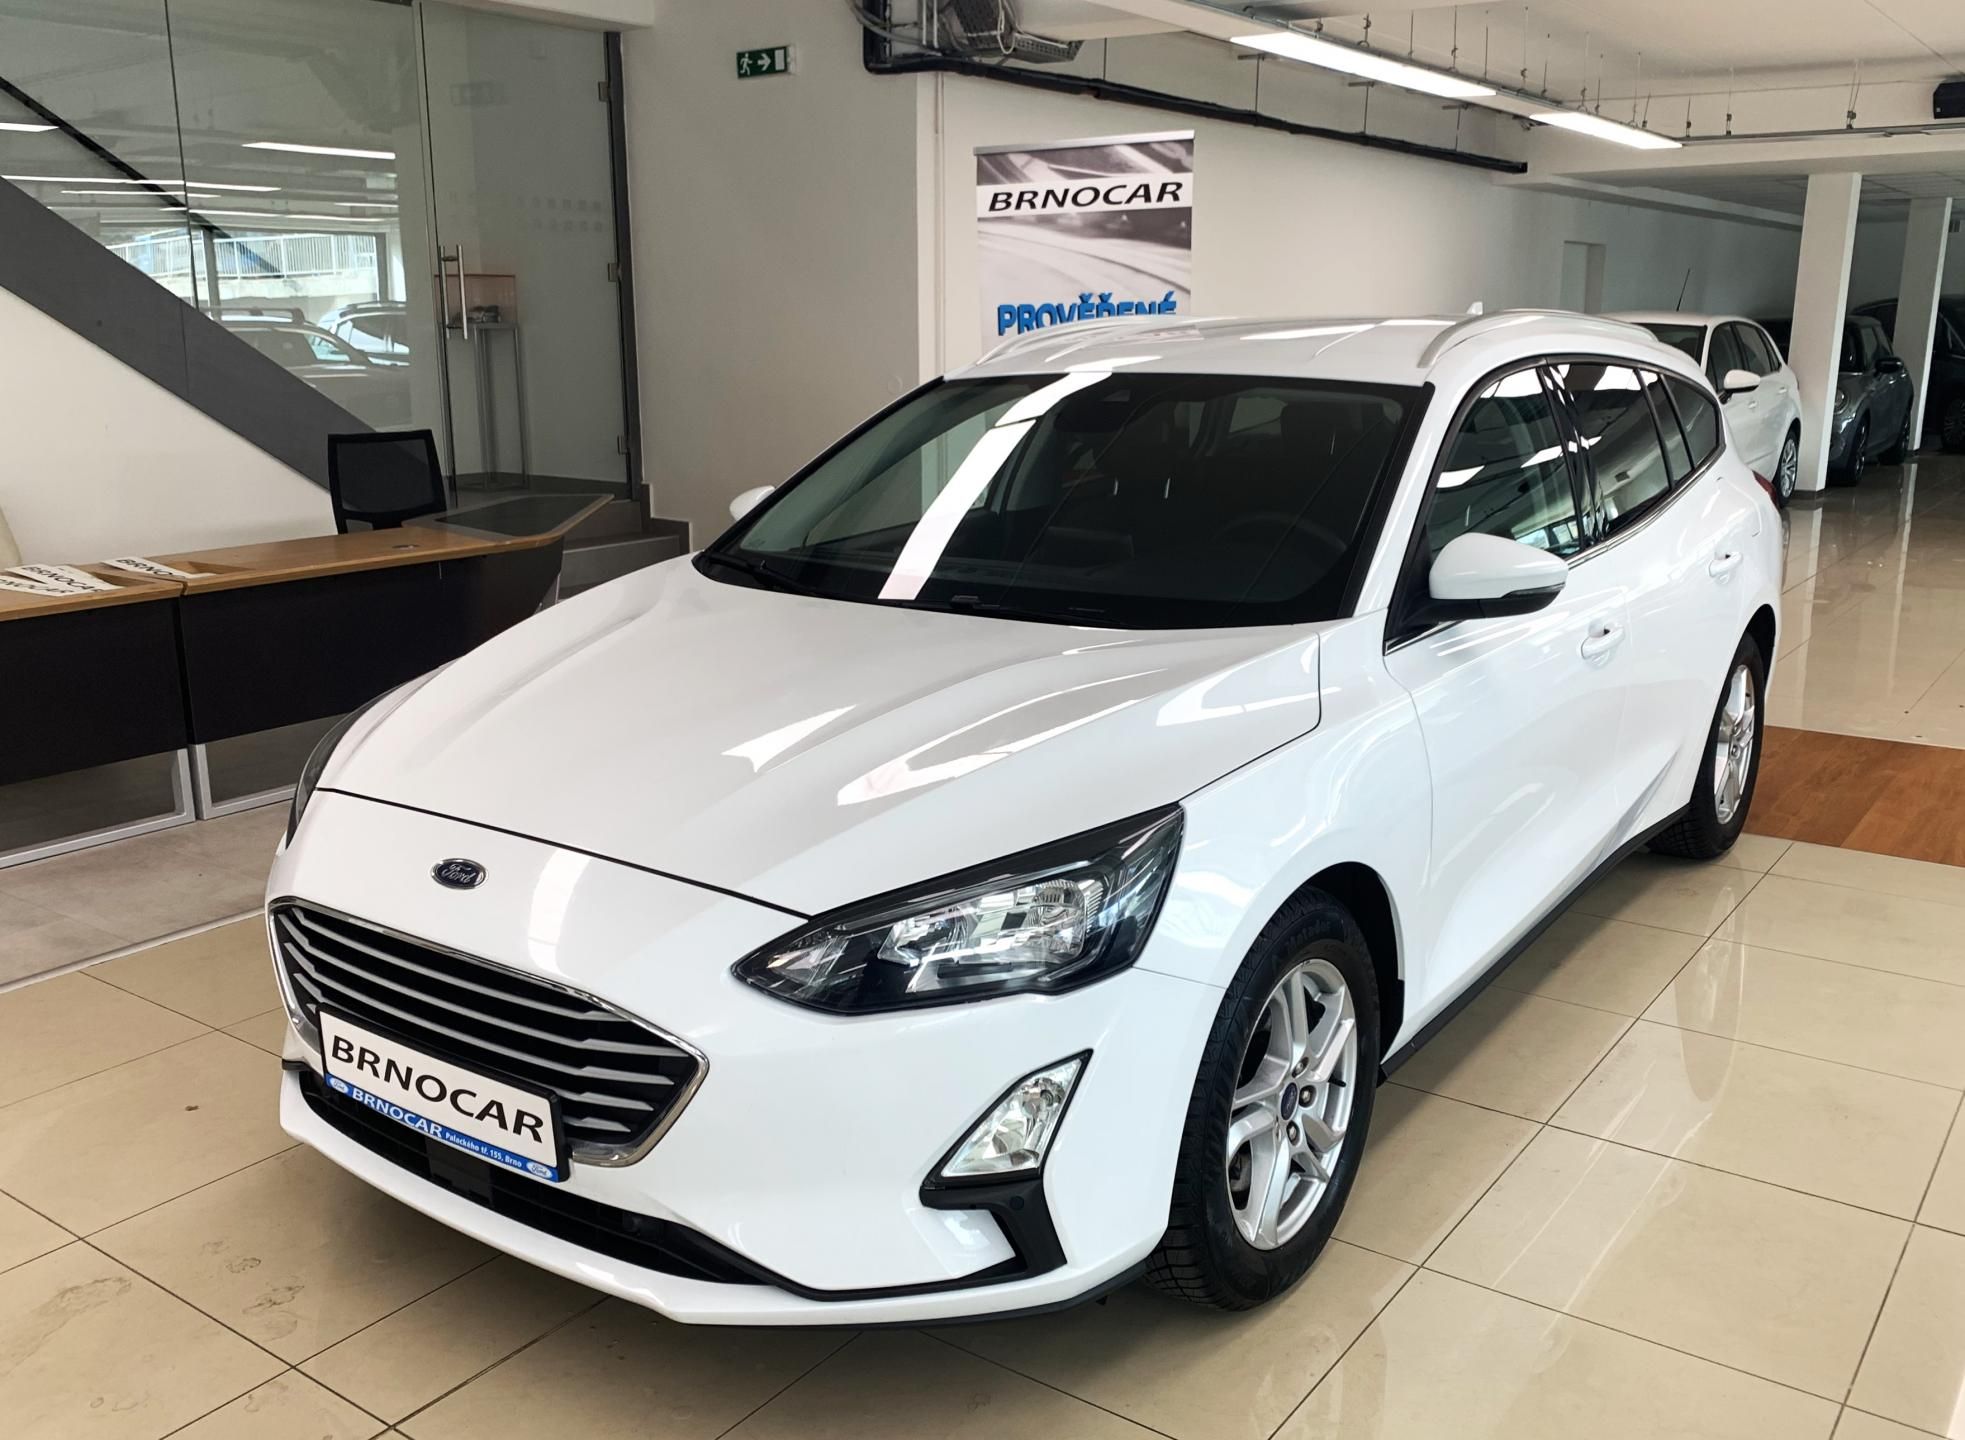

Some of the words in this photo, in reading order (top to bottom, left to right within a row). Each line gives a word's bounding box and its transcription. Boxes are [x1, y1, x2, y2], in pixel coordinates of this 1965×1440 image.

[988, 182, 1183, 212] BRNOCAR
[331, 1034, 544, 1144] BRNOCAR
[352, 1088, 442, 1138] BRNOCAR
[445, 1132, 479, 1151] Palackého
[505, 1155, 522, 1168] Brno
